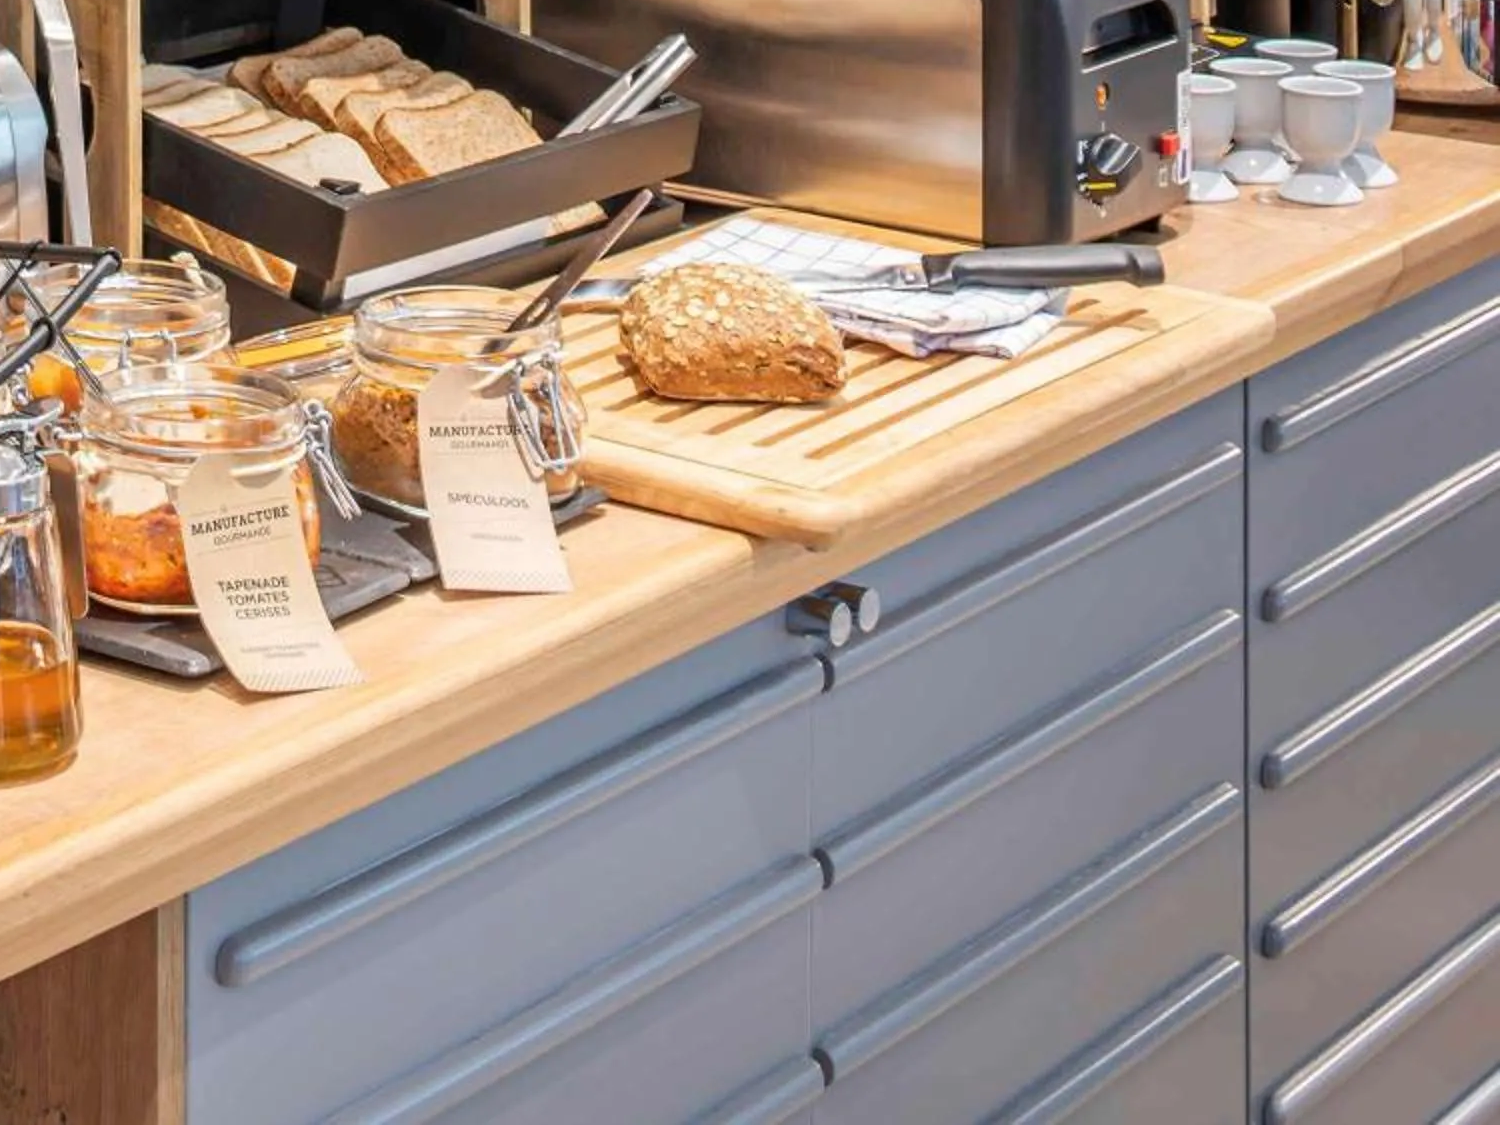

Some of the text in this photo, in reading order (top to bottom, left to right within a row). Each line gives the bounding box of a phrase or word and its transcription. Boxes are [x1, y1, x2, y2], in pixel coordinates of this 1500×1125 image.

[191, 505, 291, 536] MANUFACTURE
[213, 525, 272, 547] GOURMANDE
[216, 576, 290, 593] TAPENADE
[227, 591, 290, 607] TOMATES
[234, 606, 291, 621] CERISES
